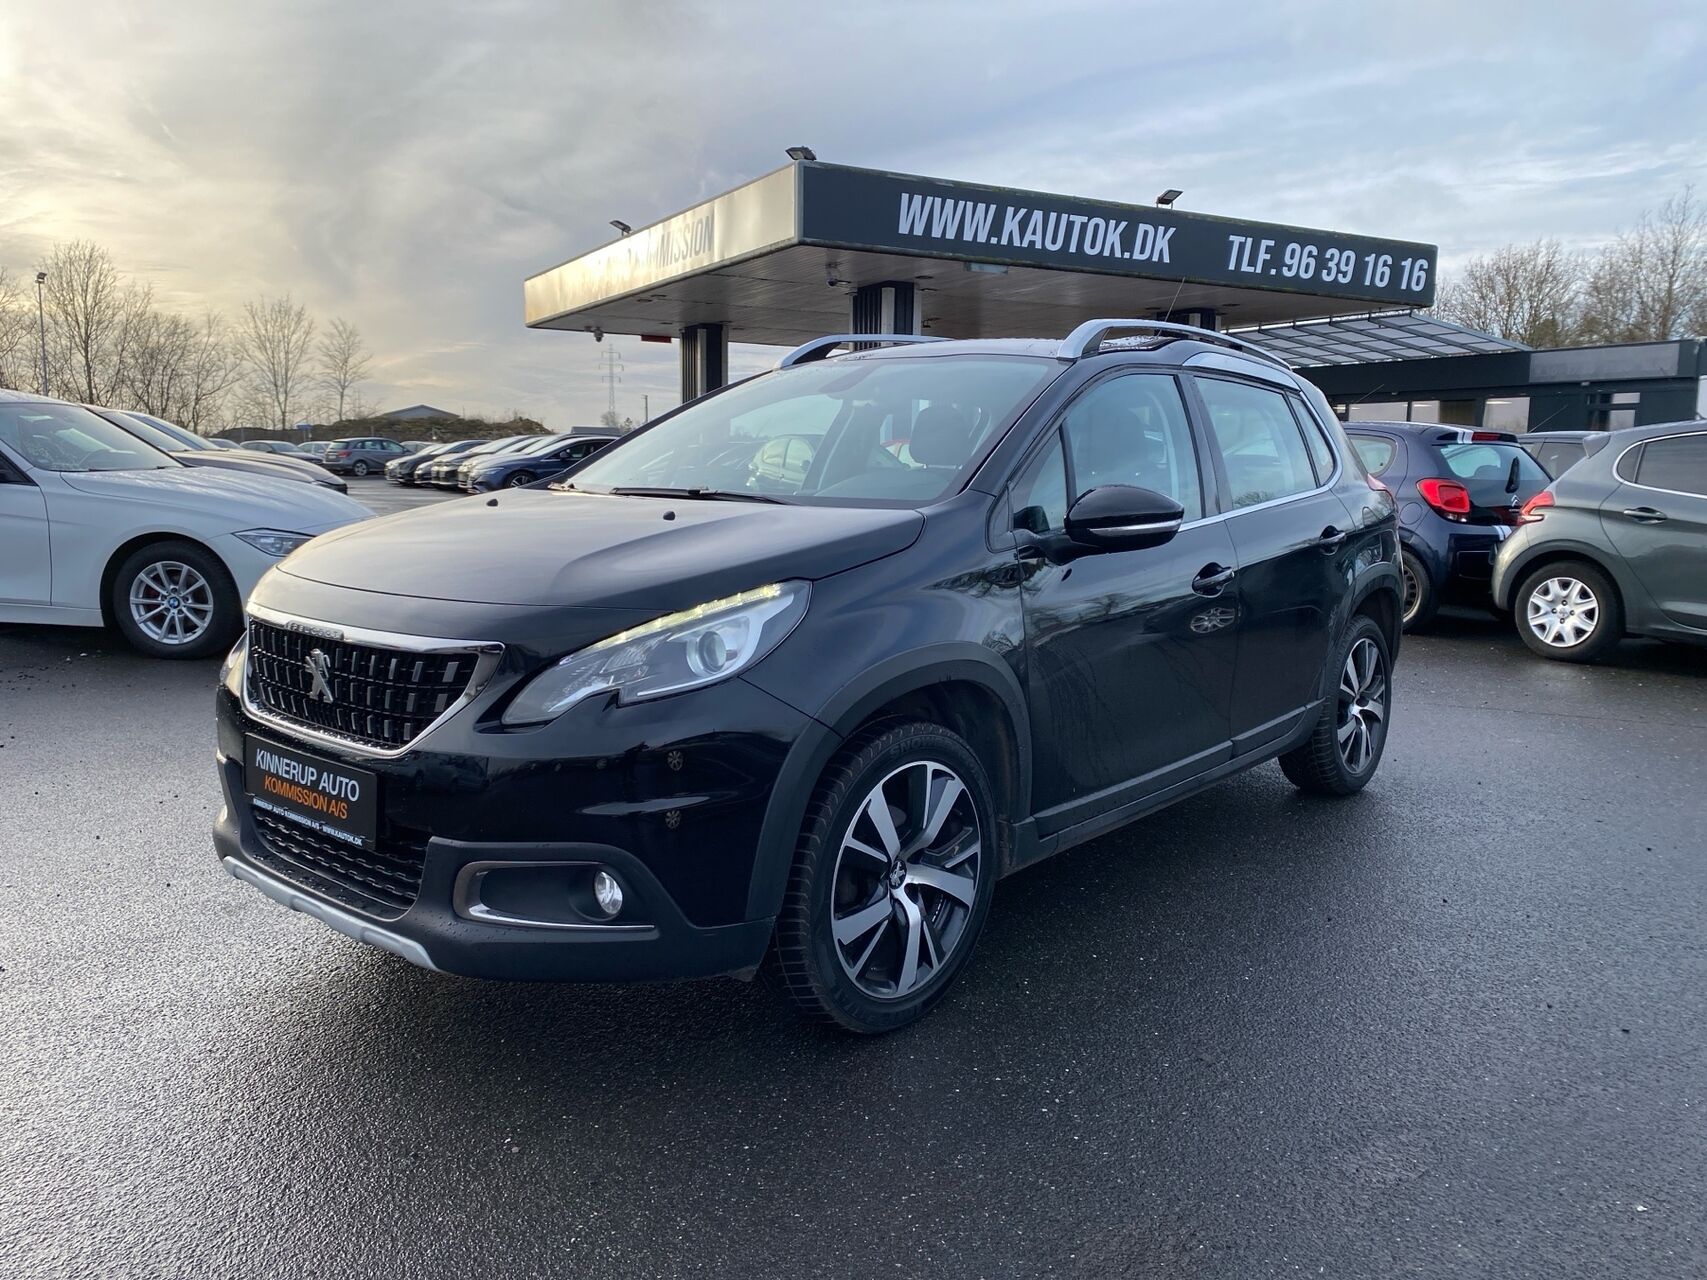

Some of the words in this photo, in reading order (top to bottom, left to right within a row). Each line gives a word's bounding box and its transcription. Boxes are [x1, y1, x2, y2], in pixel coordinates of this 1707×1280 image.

[898, 193, 1176, 264] WWW.KAUTOK.DK
[1227, 234, 1277, 276] TLF.
[1282, 242, 1318, 280] 96
[1321, 248, 1356, 284] 39
[1364, 253, 1392, 288] 16
[1400, 257, 1429, 292] 16
[255, 748, 317, 786] KINNERUP
[318, 771, 360, 802] AUTO
[264, 774, 328, 812] KOMMISSION
[328, 799, 348, 820] A/S
